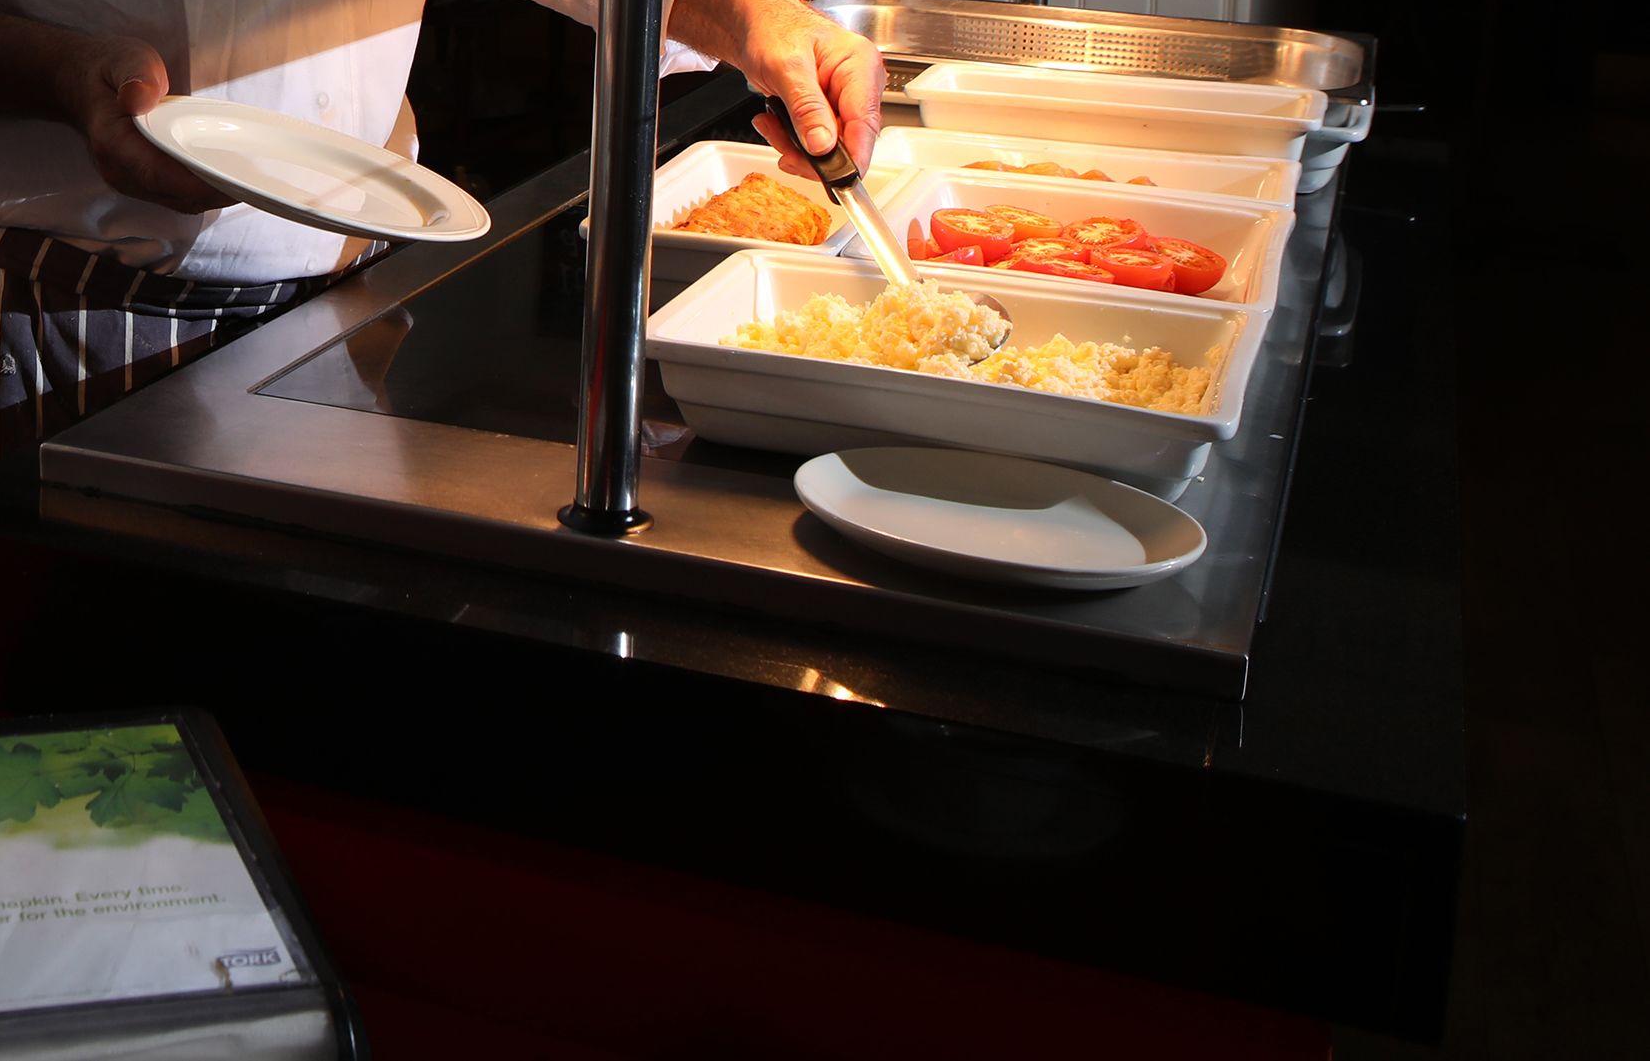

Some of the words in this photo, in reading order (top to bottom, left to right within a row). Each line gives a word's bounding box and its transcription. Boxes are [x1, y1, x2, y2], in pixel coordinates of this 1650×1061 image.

[75, 888, 132, 905] Every
[138, 883, 189, 898] time.
[19, 910, 48, 923] for
[53, 907, 88, 920] the
[93, 893, 228, 917] environment.
[221, 949, 277, 967] TORK
